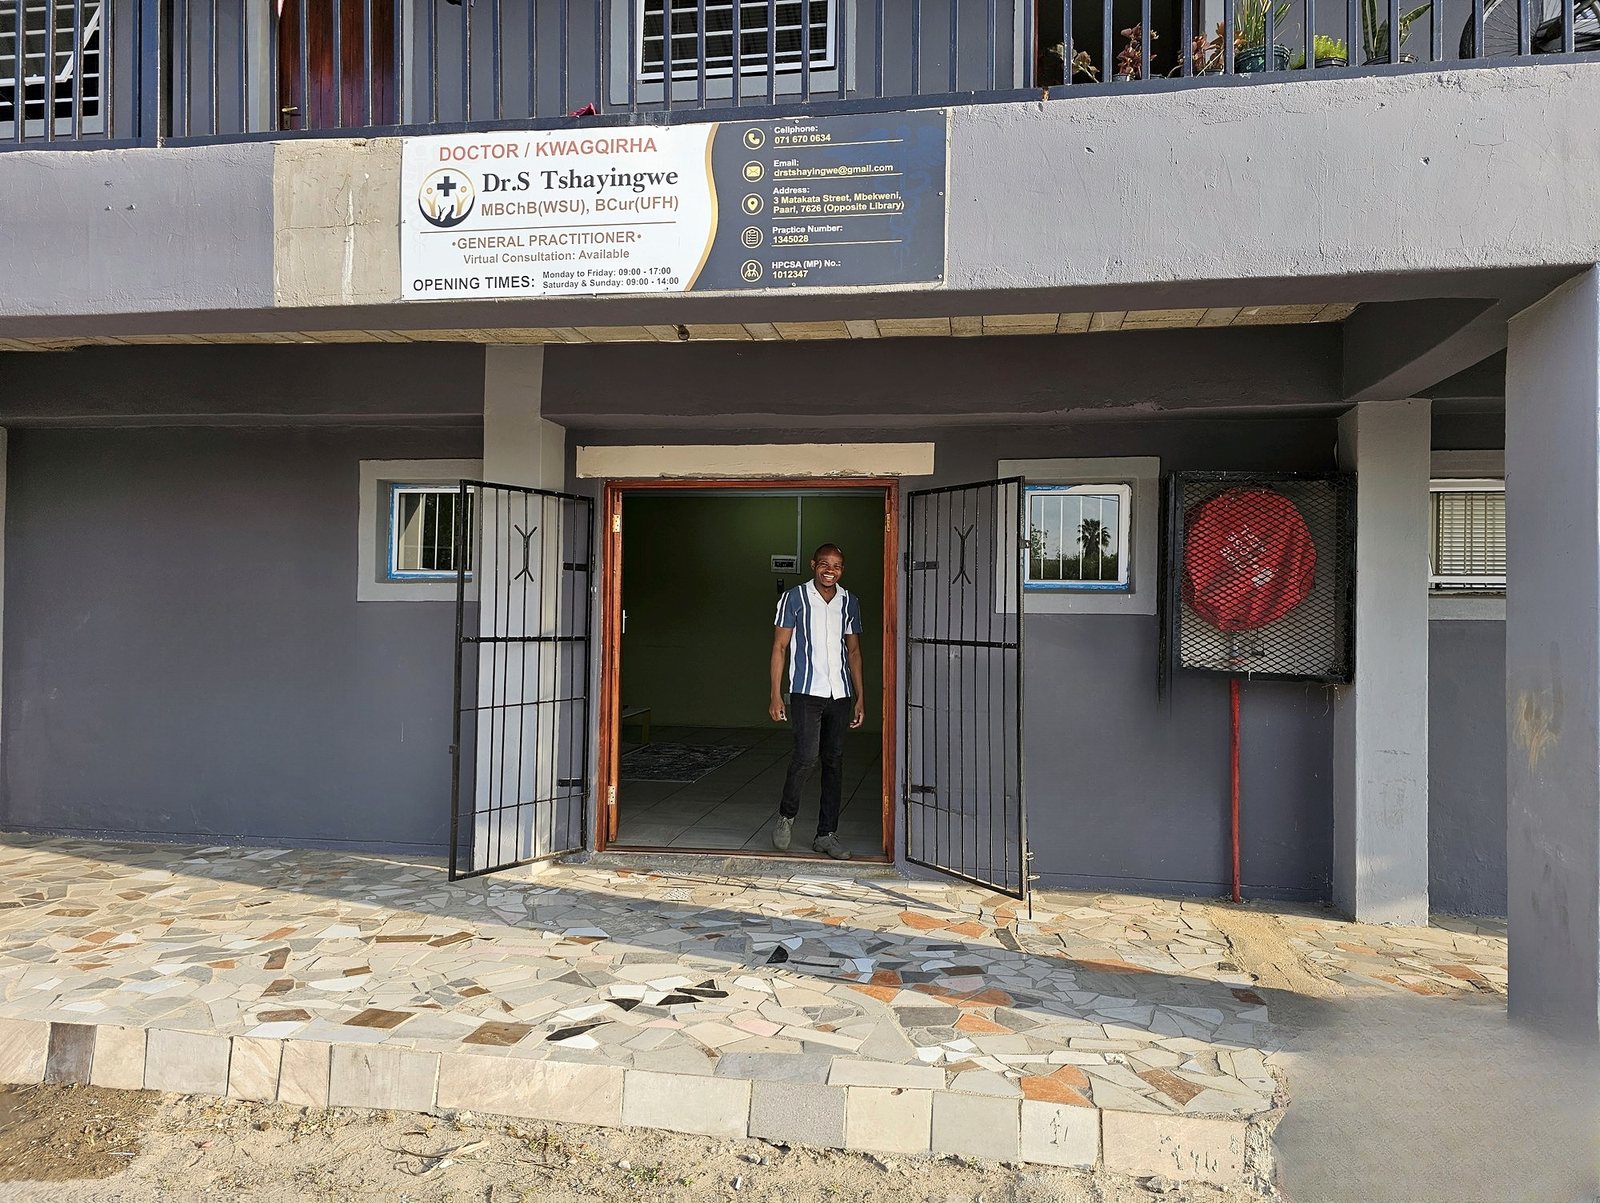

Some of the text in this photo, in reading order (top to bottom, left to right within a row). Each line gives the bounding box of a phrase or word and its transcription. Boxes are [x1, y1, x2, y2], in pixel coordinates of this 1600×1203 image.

[774, 125, 819, 135] Cellphone:
[774, 133, 832, 144] 071 670 0634
[440, 144, 519, 161] DOCTOR
[535, 137, 658, 157] KWAGQIRHA
[773, 159, 799, 167] Email:
[773, 164, 894, 177] drstshayingwe@gmail.com
[481, 167, 679, 195] Dr.S Tshayingwe
[773, 187, 810, 195] Address:
[773, 191, 902, 206] 3 Matakata Street, Mbekweni,
[481, 195, 679, 217] MBChB(WSU), BCur(UFH)
[773, 200, 905, 215] Paarl, 7626 (Opposite Library)
[772, 224, 843, 235] Practice Number:
[772, 235, 809, 244] 1345028
[463, 248, 630, 264] Virtual Consultation: Available
[771, 259, 841, 270] HPCSA (MP) No.:
[542, 271, 574, 280] Monday
[576, 270, 585, 278] to
[587, 269, 616, 277] Friday:
[618, 268, 641, 276] 09:00
[649, 266, 672, 275] 17:00
[772, 270, 809, 279] 1012347
[412, 275, 535, 292] OPENING TIMES:
[542, 280, 579, 289] Saturday
[581, 280, 587, 288] &
[589, 279, 624, 287] Sunday:
[626, 278, 649, 286] 09:00
[657, 277, 679, 285] 14:00
